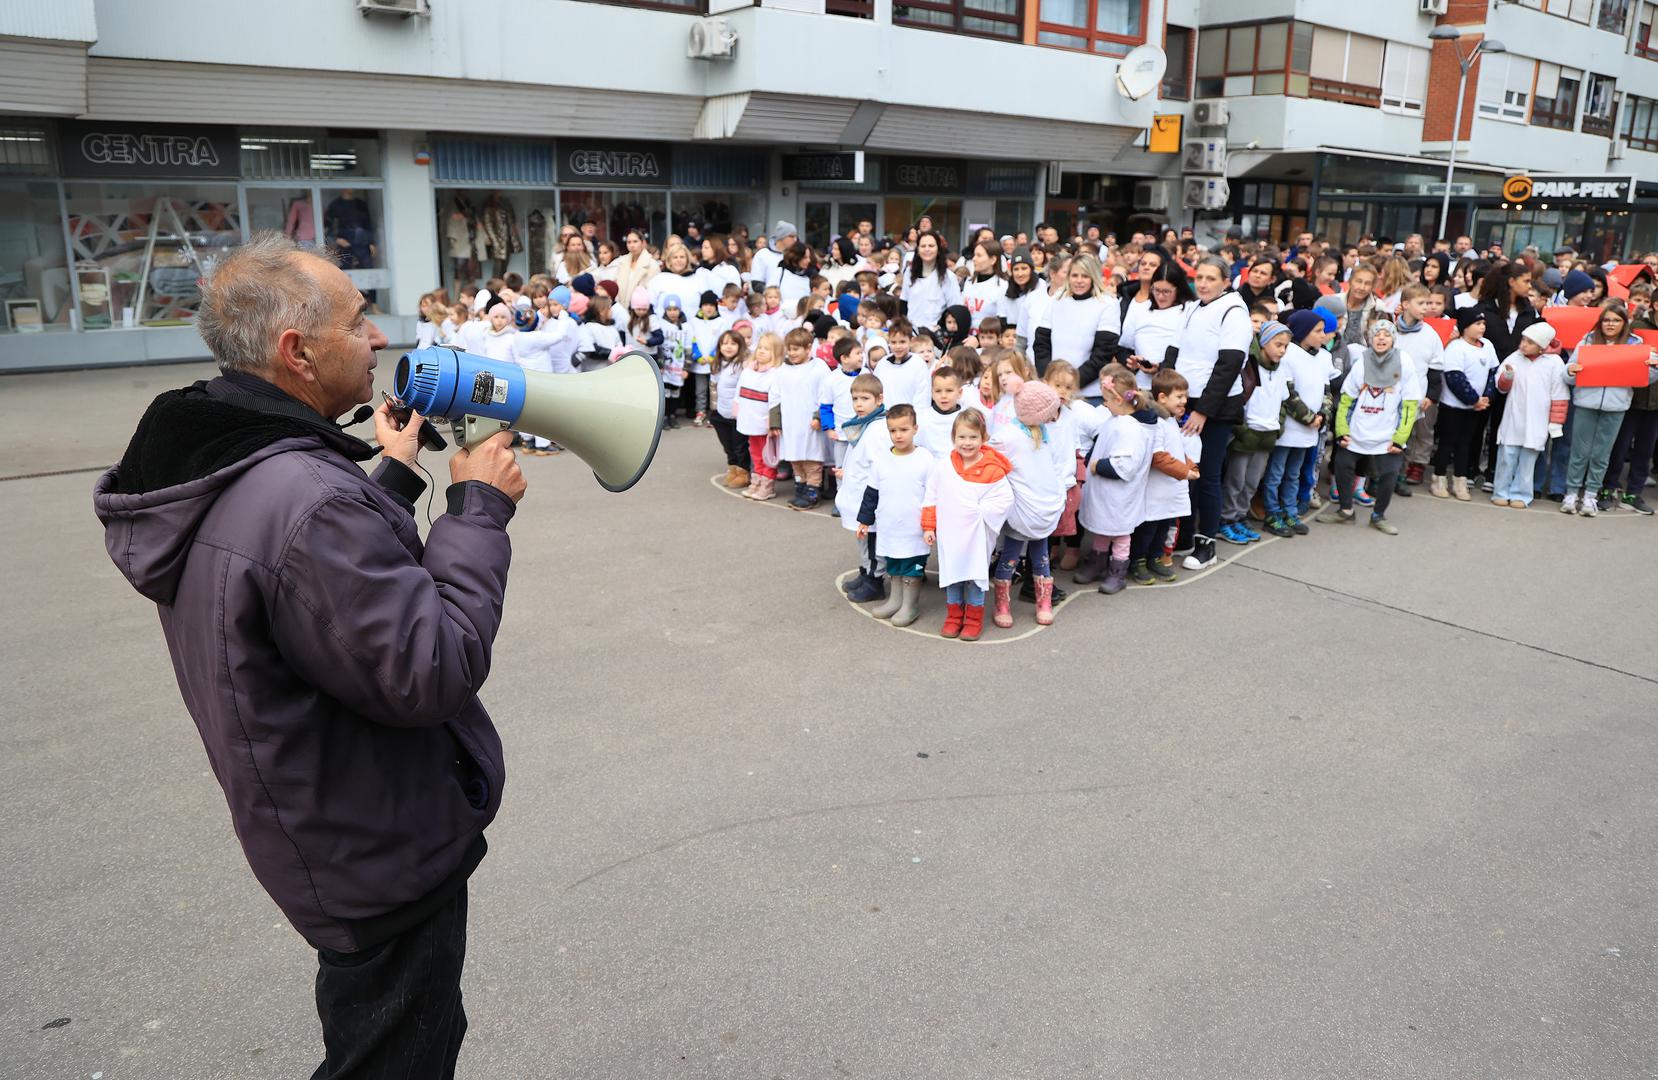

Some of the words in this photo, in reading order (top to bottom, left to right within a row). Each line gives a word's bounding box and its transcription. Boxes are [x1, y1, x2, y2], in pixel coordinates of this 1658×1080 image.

[81, 132, 220, 166] CENTRA
[569, 149, 660, 177] CENTRA
[895, 164, 959, 188] CENTRA
[1531, 181, 1620, 198] PAN-PEK
